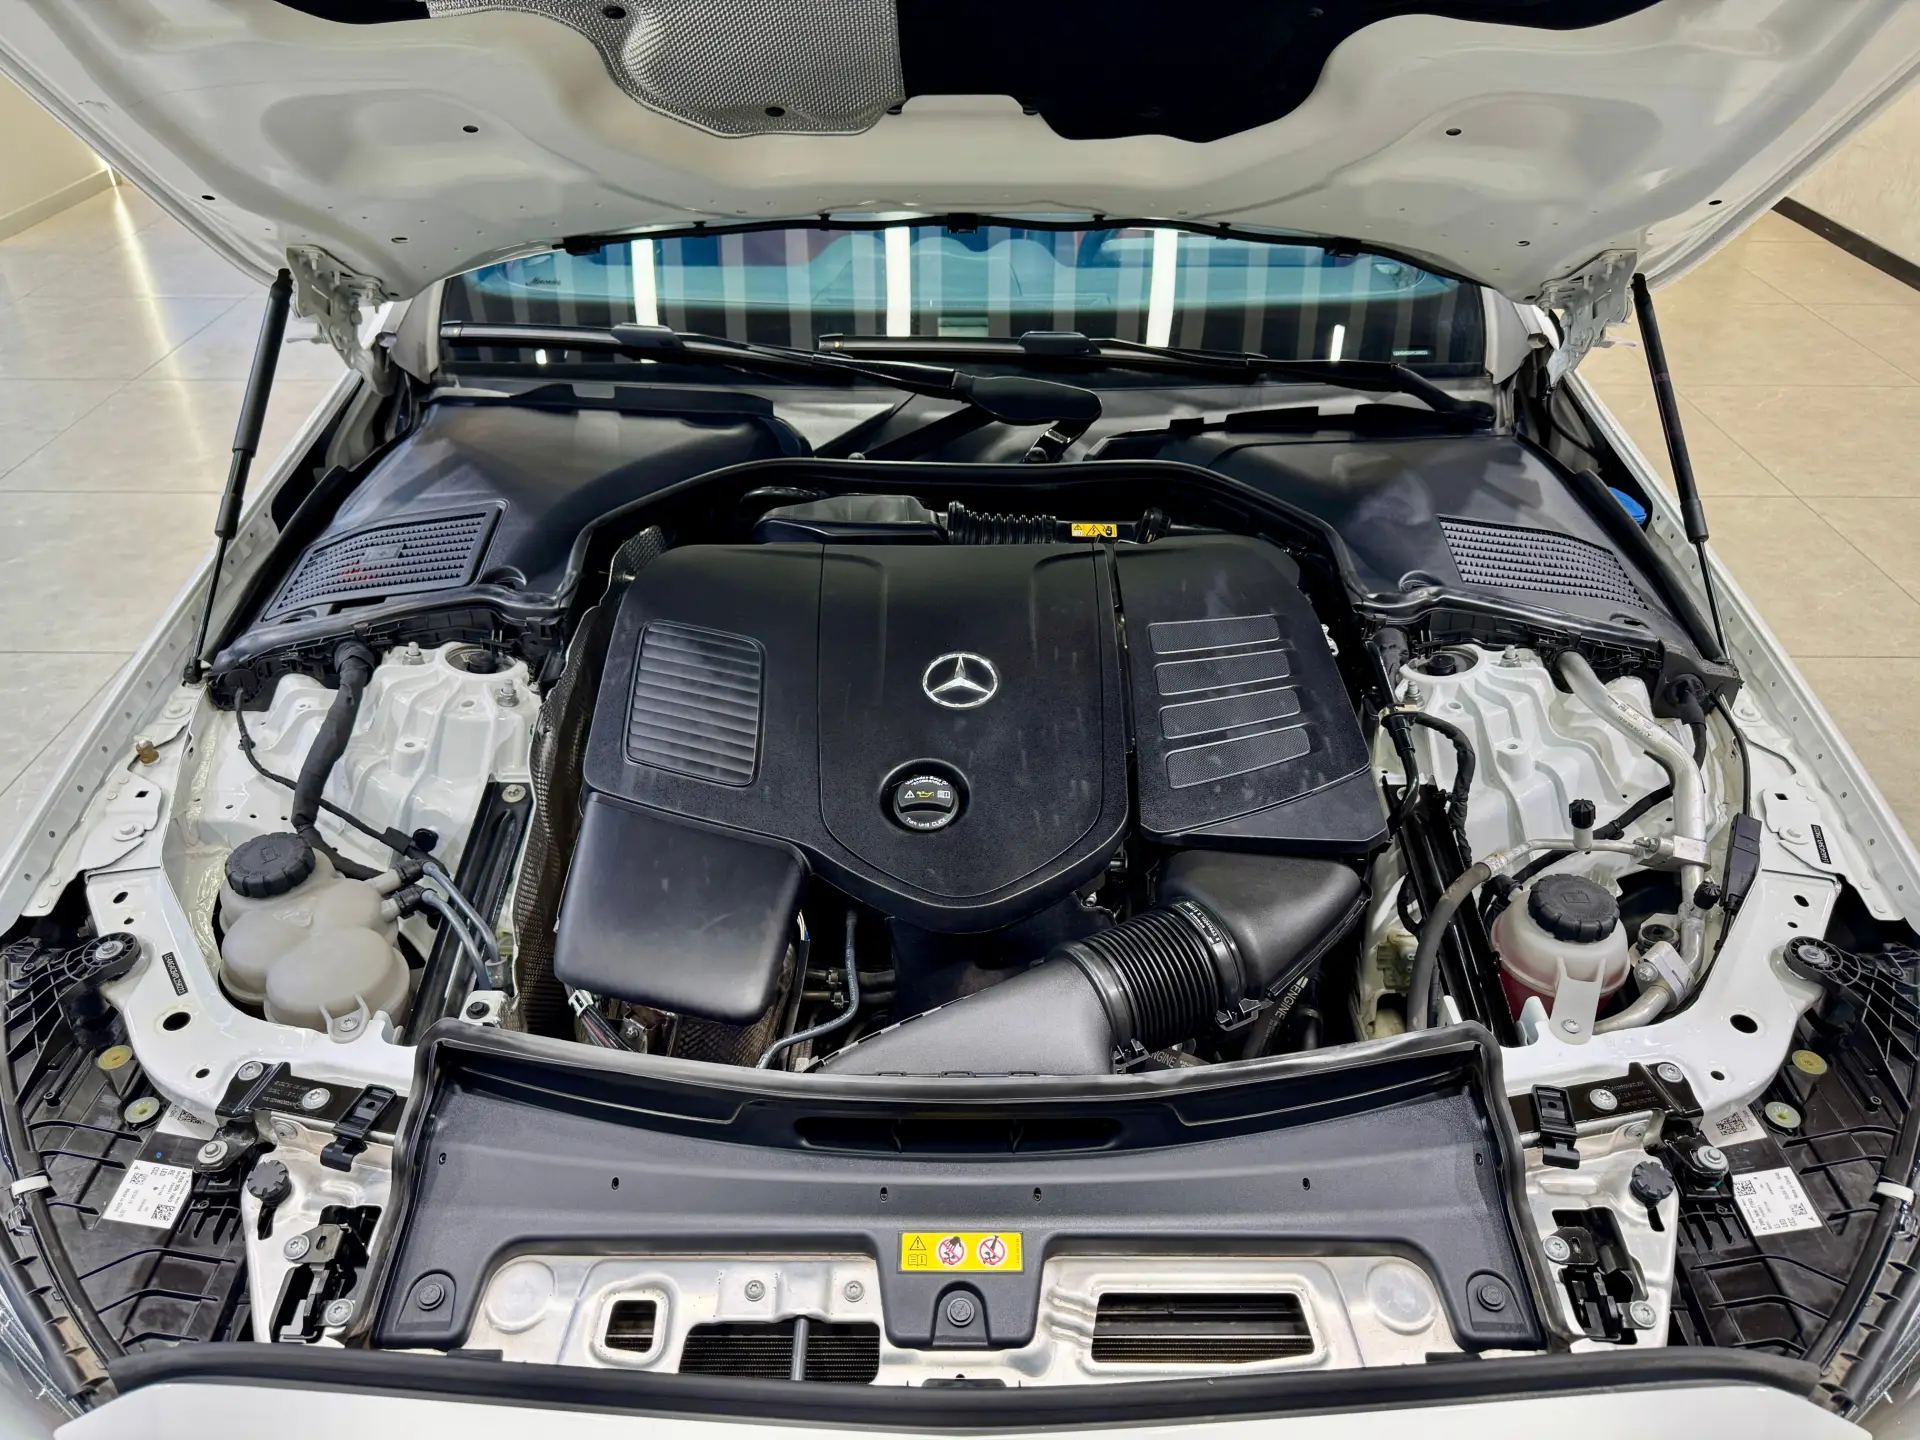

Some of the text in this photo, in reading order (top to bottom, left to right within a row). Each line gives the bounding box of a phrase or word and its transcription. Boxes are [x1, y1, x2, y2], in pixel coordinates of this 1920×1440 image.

[906, 816, 917, 826] Turn
[931, 817, 947, 827] CLICK
[1275, 984, 1302, 1020] ENGINE
